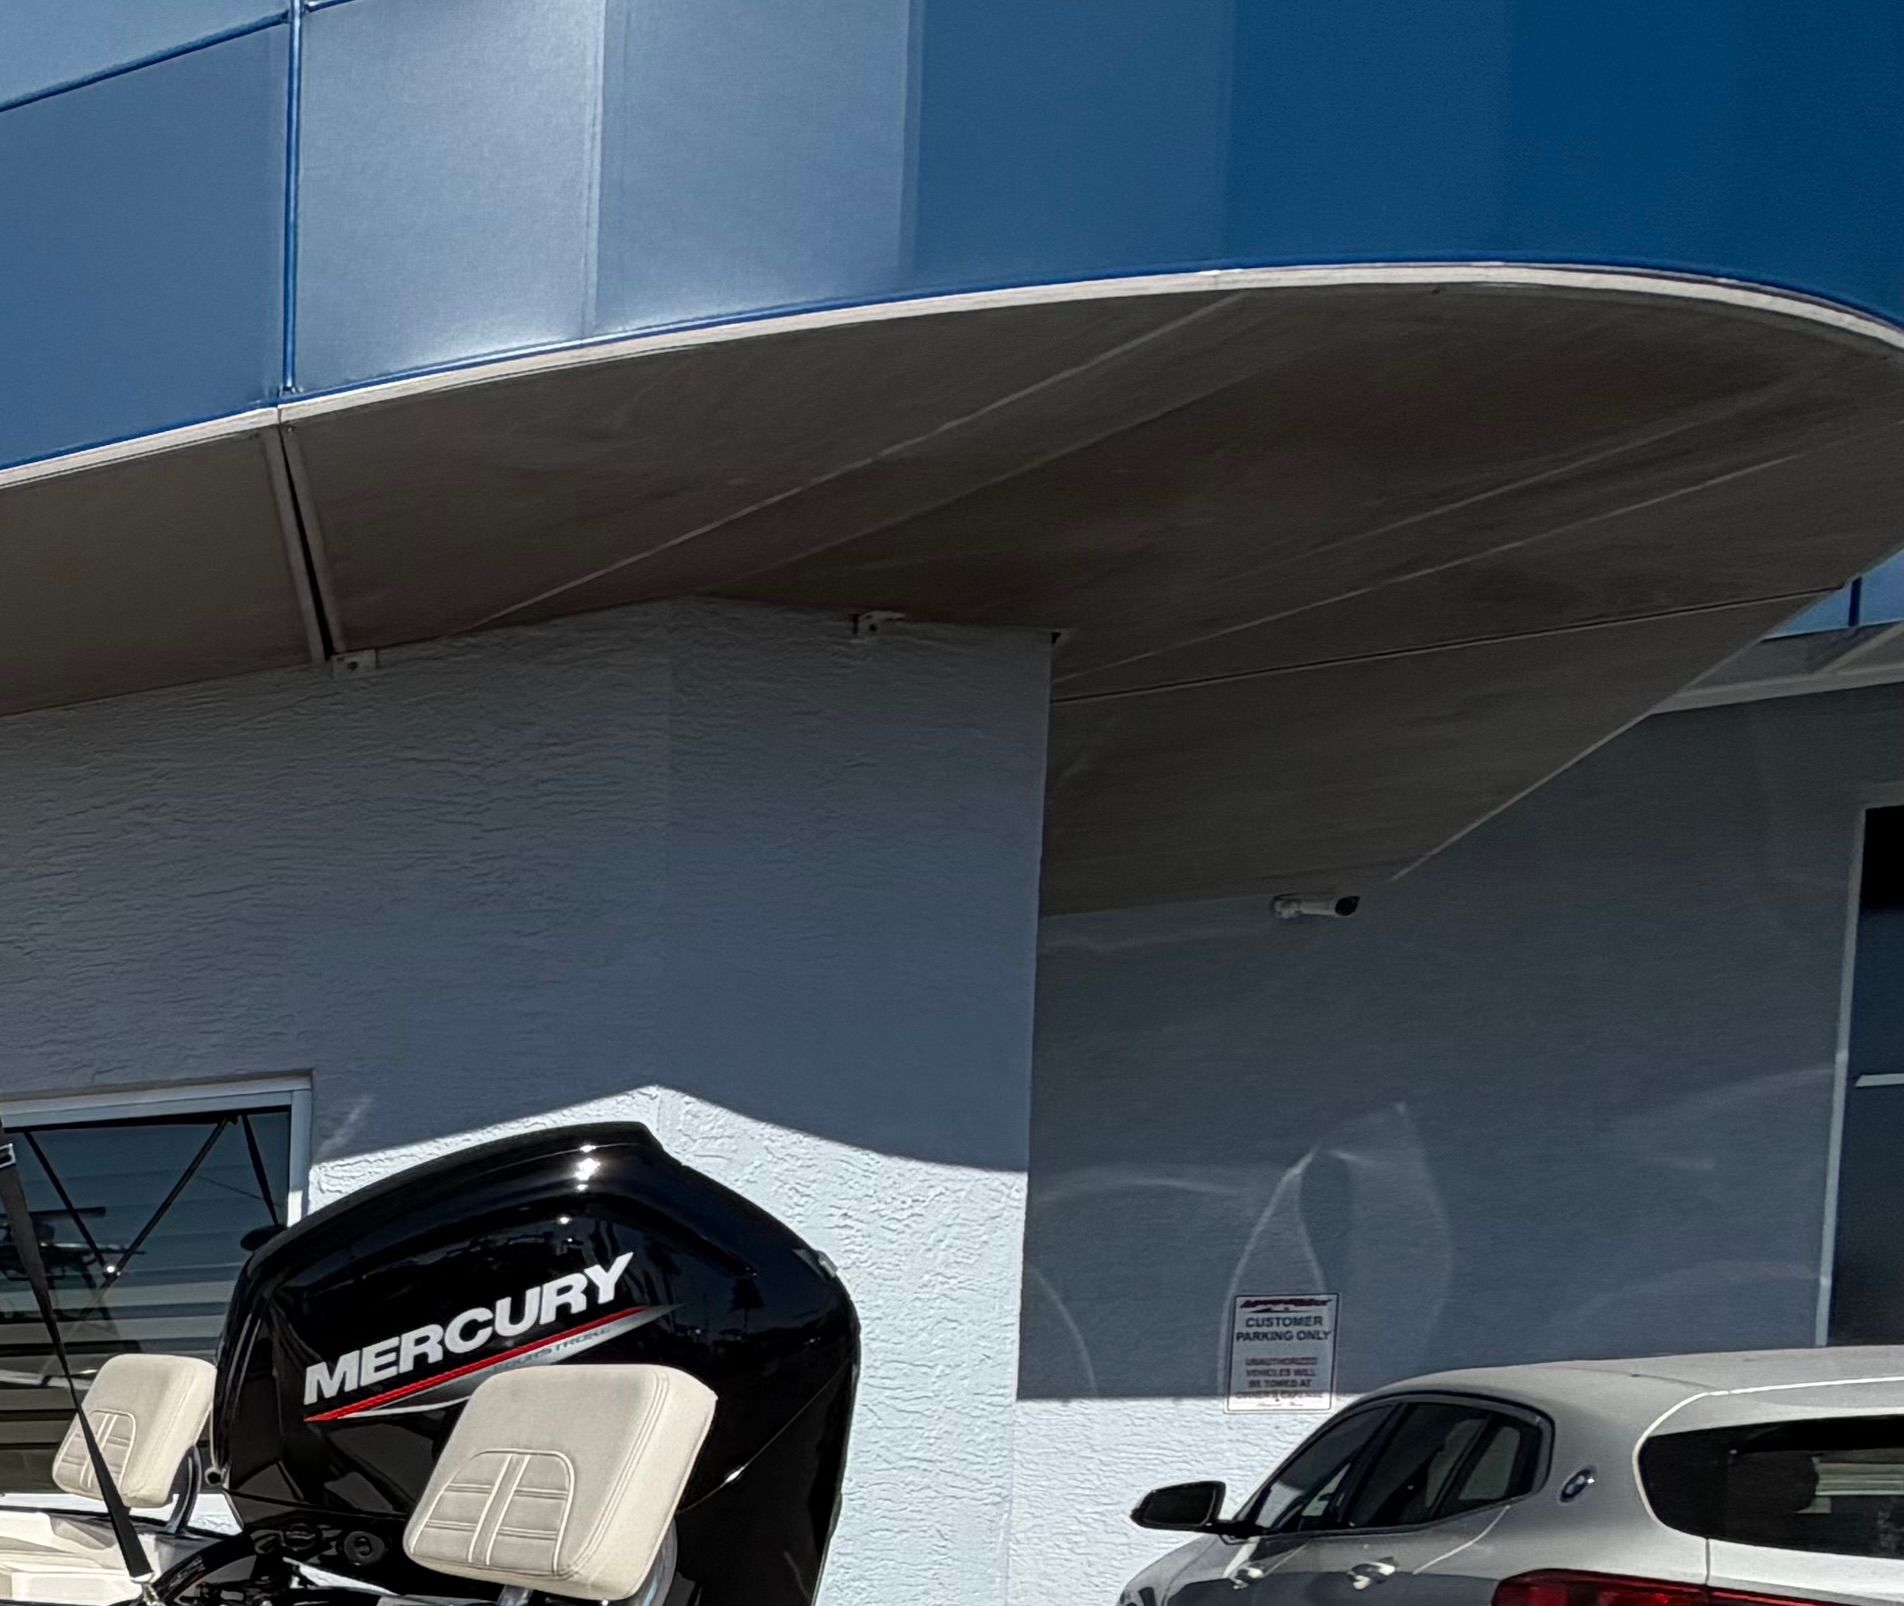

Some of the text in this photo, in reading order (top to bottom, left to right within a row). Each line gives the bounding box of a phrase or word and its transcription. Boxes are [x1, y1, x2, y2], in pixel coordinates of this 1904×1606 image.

[1245, 1316, 1324, 1327] CUSTOMER
[303, 1251, 634, 1406] MERCURY
[1236, 1330, 1332, 1341] PARKING ONLY
